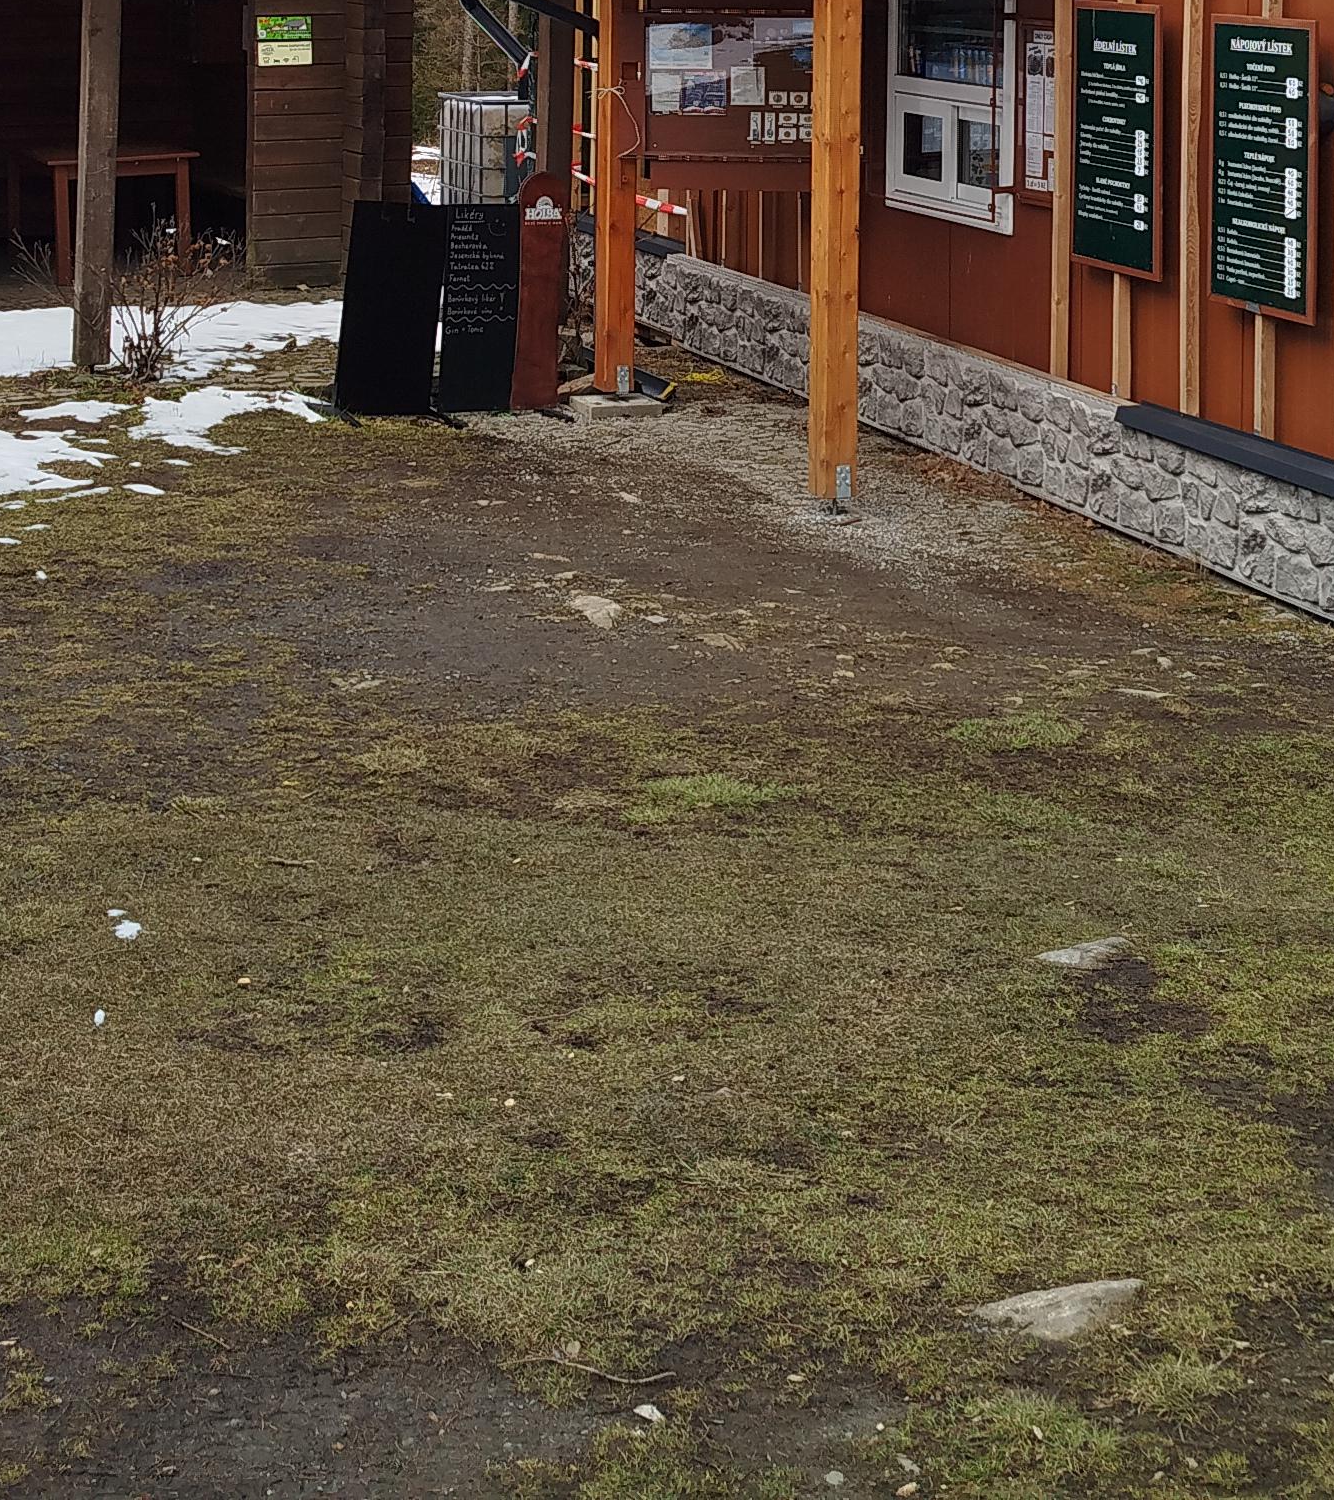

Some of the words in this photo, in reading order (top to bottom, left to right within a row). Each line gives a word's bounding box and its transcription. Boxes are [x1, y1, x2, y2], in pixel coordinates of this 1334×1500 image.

[1230, 36, 1267, 51] NÁPOJOVÝ
[1267, 39, 1293, 55] LÍSTEK
[455, 208, 484, 220] Likéry
[445, 326, 459, 335] Gin
